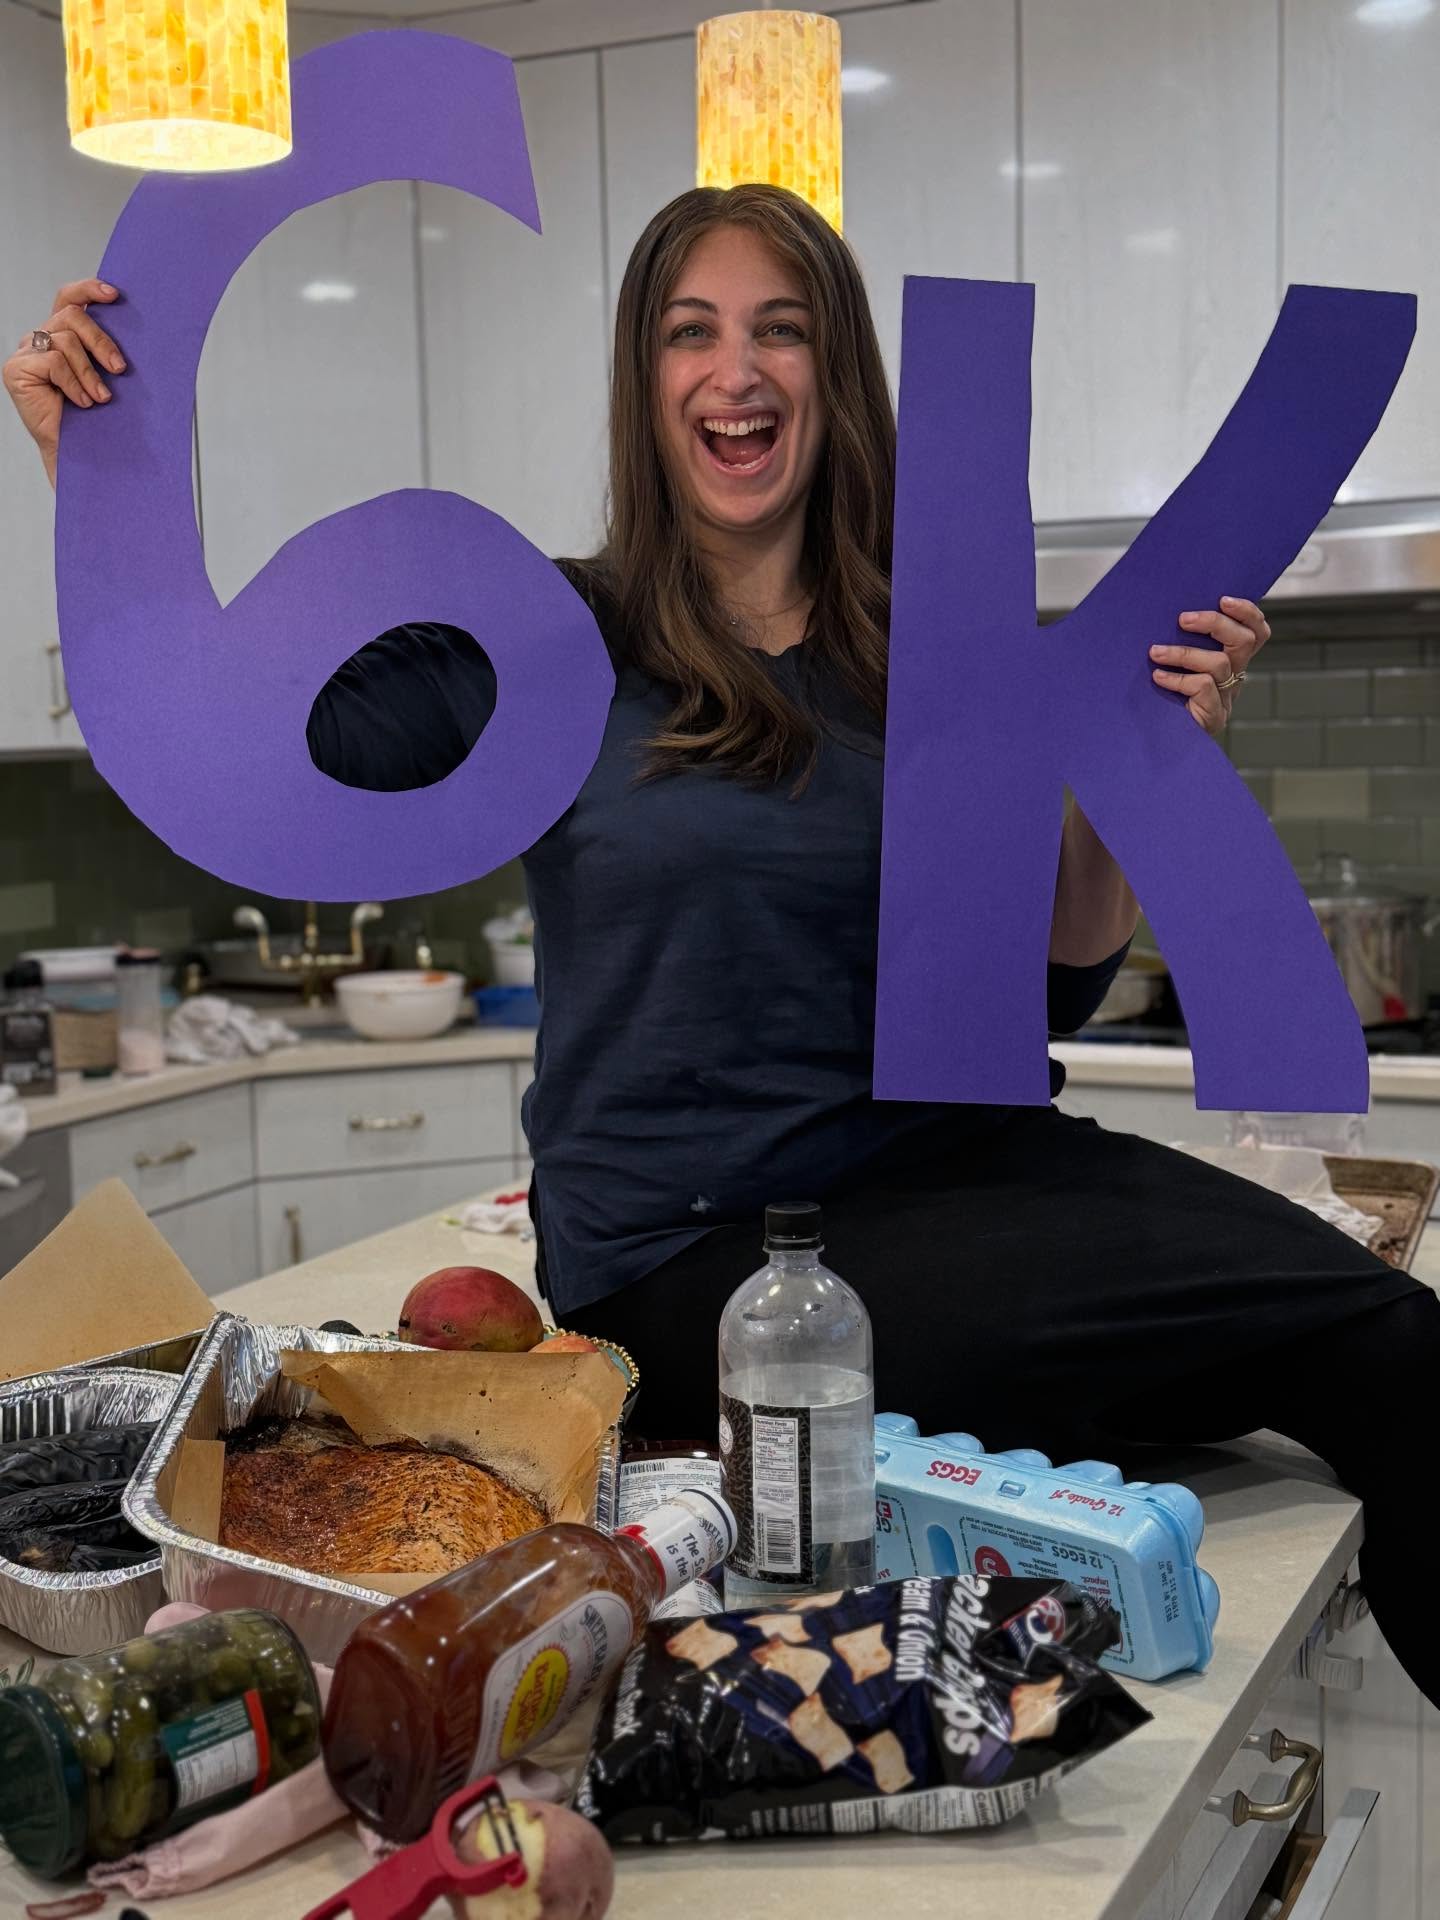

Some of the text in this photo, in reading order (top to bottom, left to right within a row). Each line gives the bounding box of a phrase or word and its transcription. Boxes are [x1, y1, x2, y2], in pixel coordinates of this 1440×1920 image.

[926, 1460, 983, 1486] EGGS
[1067, 1492, 1108, 1512] Grade
[1107, 1503, 1126, 1517] 12
[682, 1532, 700, 1558] The
[1050, 1545, 1088, 1566] EGGS
[665, 1543, 679, 1555] is
[674, 1556, 689, 1577] the
[1089, 1555, 1104, 1570] 12
[901, 1575, 941, 1611] ream
